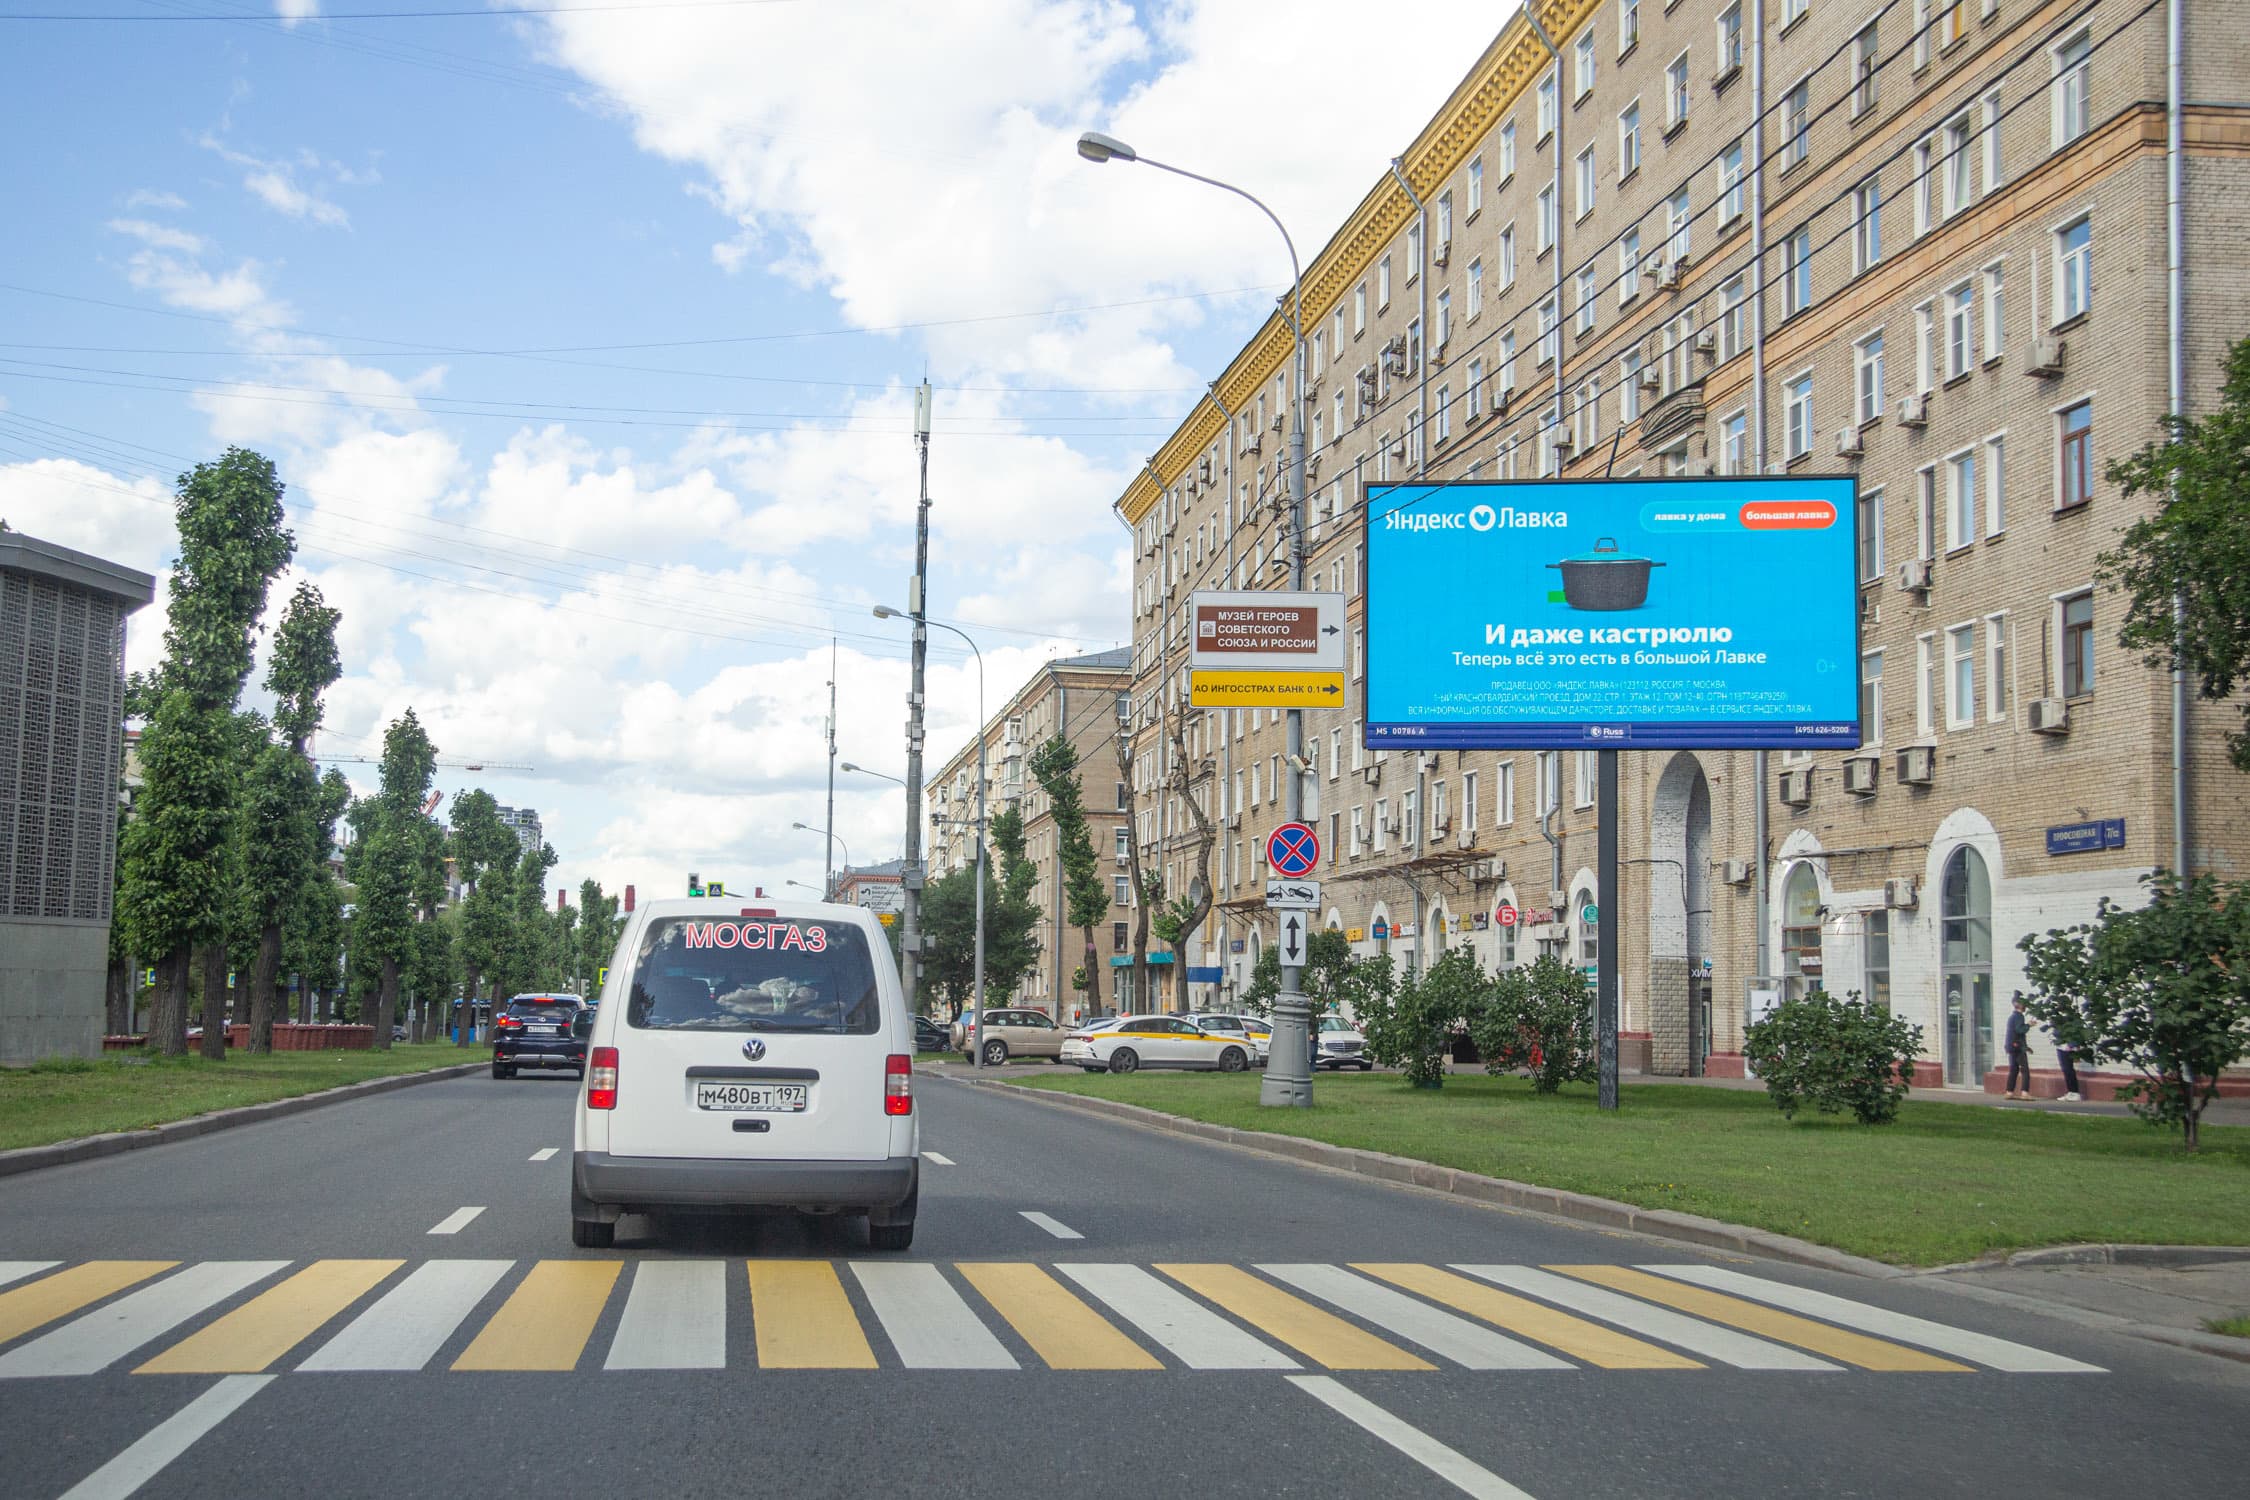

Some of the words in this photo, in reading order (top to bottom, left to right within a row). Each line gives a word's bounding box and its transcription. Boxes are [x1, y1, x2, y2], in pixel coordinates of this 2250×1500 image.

[1385, 508, 1465, 532] Яндекс
[1498, 507, 1568, 528] Лавка
[1654, 512, 1687, 521] лавка
[1688, 512, 1695, 522] у
[1696, 512, 1726, 522] дома
[1745, 510, 1796, 520] большая
[1797, 511, 1830, 519] лавка
[1218, 611, 1254, 621] МУЗЕЙ
[1257, 612, 1300, 621] ГЕРОЕВ
[1218, 625, 1290, 635] СОВЕТСКОГО
[1485, 624, 1505, 644] И
[1510, 627, 1584, 648] даже
[1589, 626, 1733, 647] кастрюлю
[1217, 638, 1258, 648] СОЮЗА
[1260, 639, 1268, 648] И
[1271, 639, 1316, 648] РОССИИ
[1452, 652, 1512, 668] Теперь
[1516, 651, 1543, 665] всё
[1549, 653, 1576, 665] это
[1580, 653, 1617, 665] есть
[1620, 653, 1630, 665] в
[1634, 650, 1710, 665] большой
[1714, 650, 1767, 665] Лавке
[1194, 685, 1208, 693] АО
[1211, 685, 1275, 693] ИНГОССТРАХ
[1278, 685, 1304, 693] БАНК
[1603, 727, 1624, 736] Russ
[1815, 726, 1849, 734] 626-5200
[685, 922, 828, 953] МОСГАЗ
[704, 1087, 772, 1105] М480ВТ
[776, 1088, 801, 1101] 197
